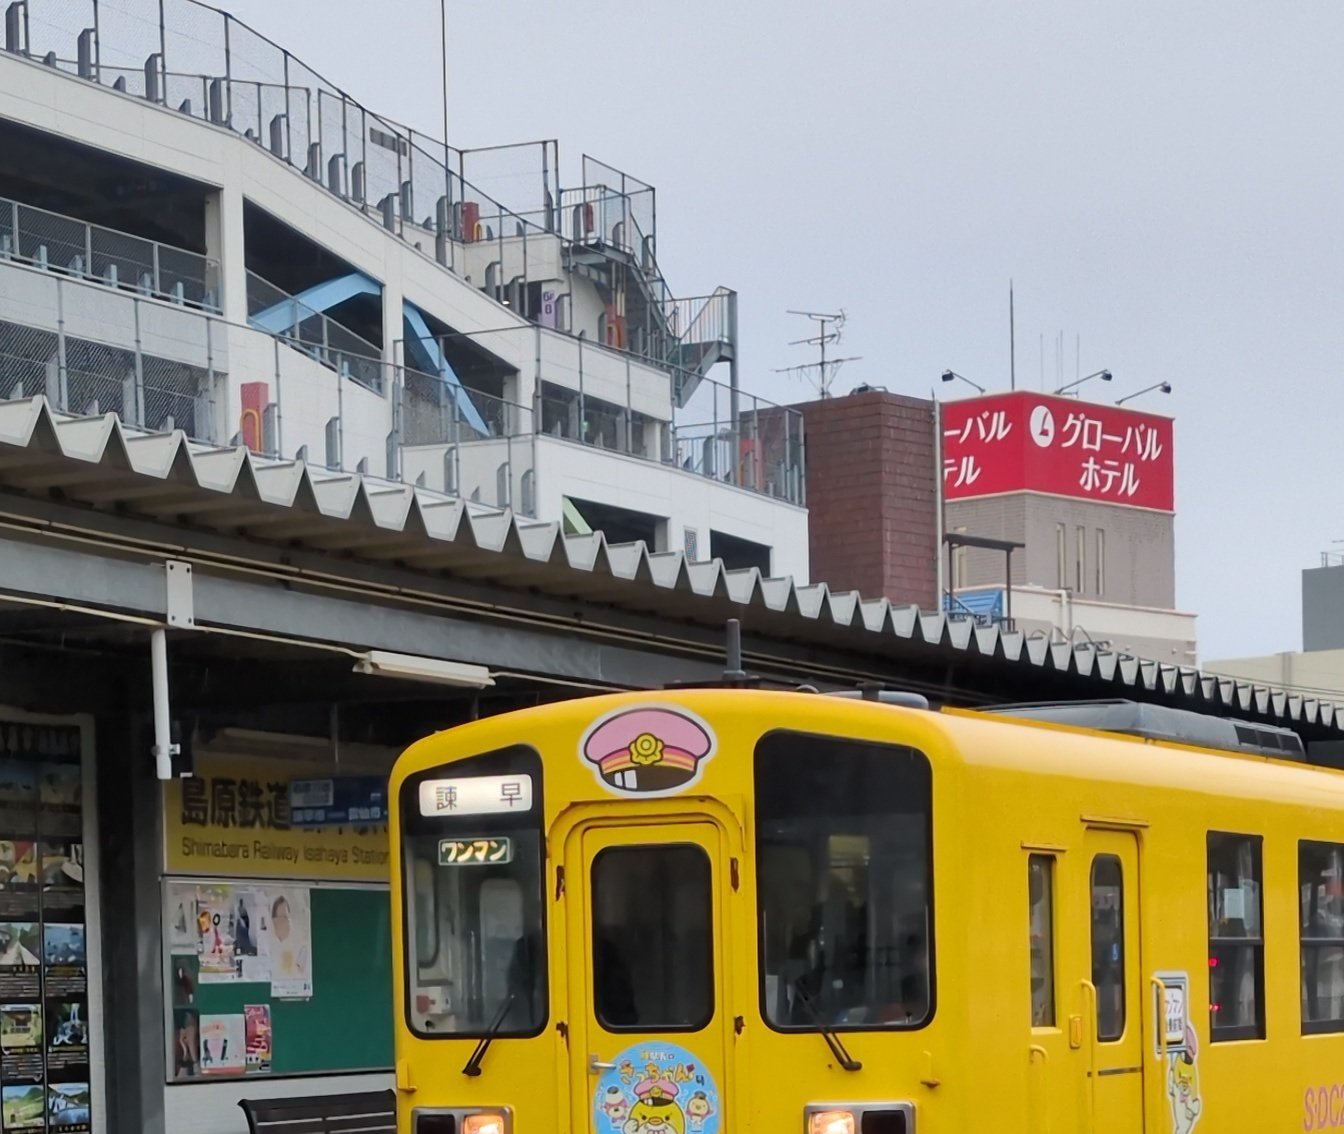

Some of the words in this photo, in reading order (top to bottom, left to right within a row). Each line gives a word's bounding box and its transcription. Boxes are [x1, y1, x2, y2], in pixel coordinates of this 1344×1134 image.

[1061, 413, 1163, 462] グローバル
[1079, 457, 1140, 497] ホテル
[182, 836, 250, 860] Shimabara
[253, 841, 298, 864] Railway
[441, 841, 506, 862] ワンマン
